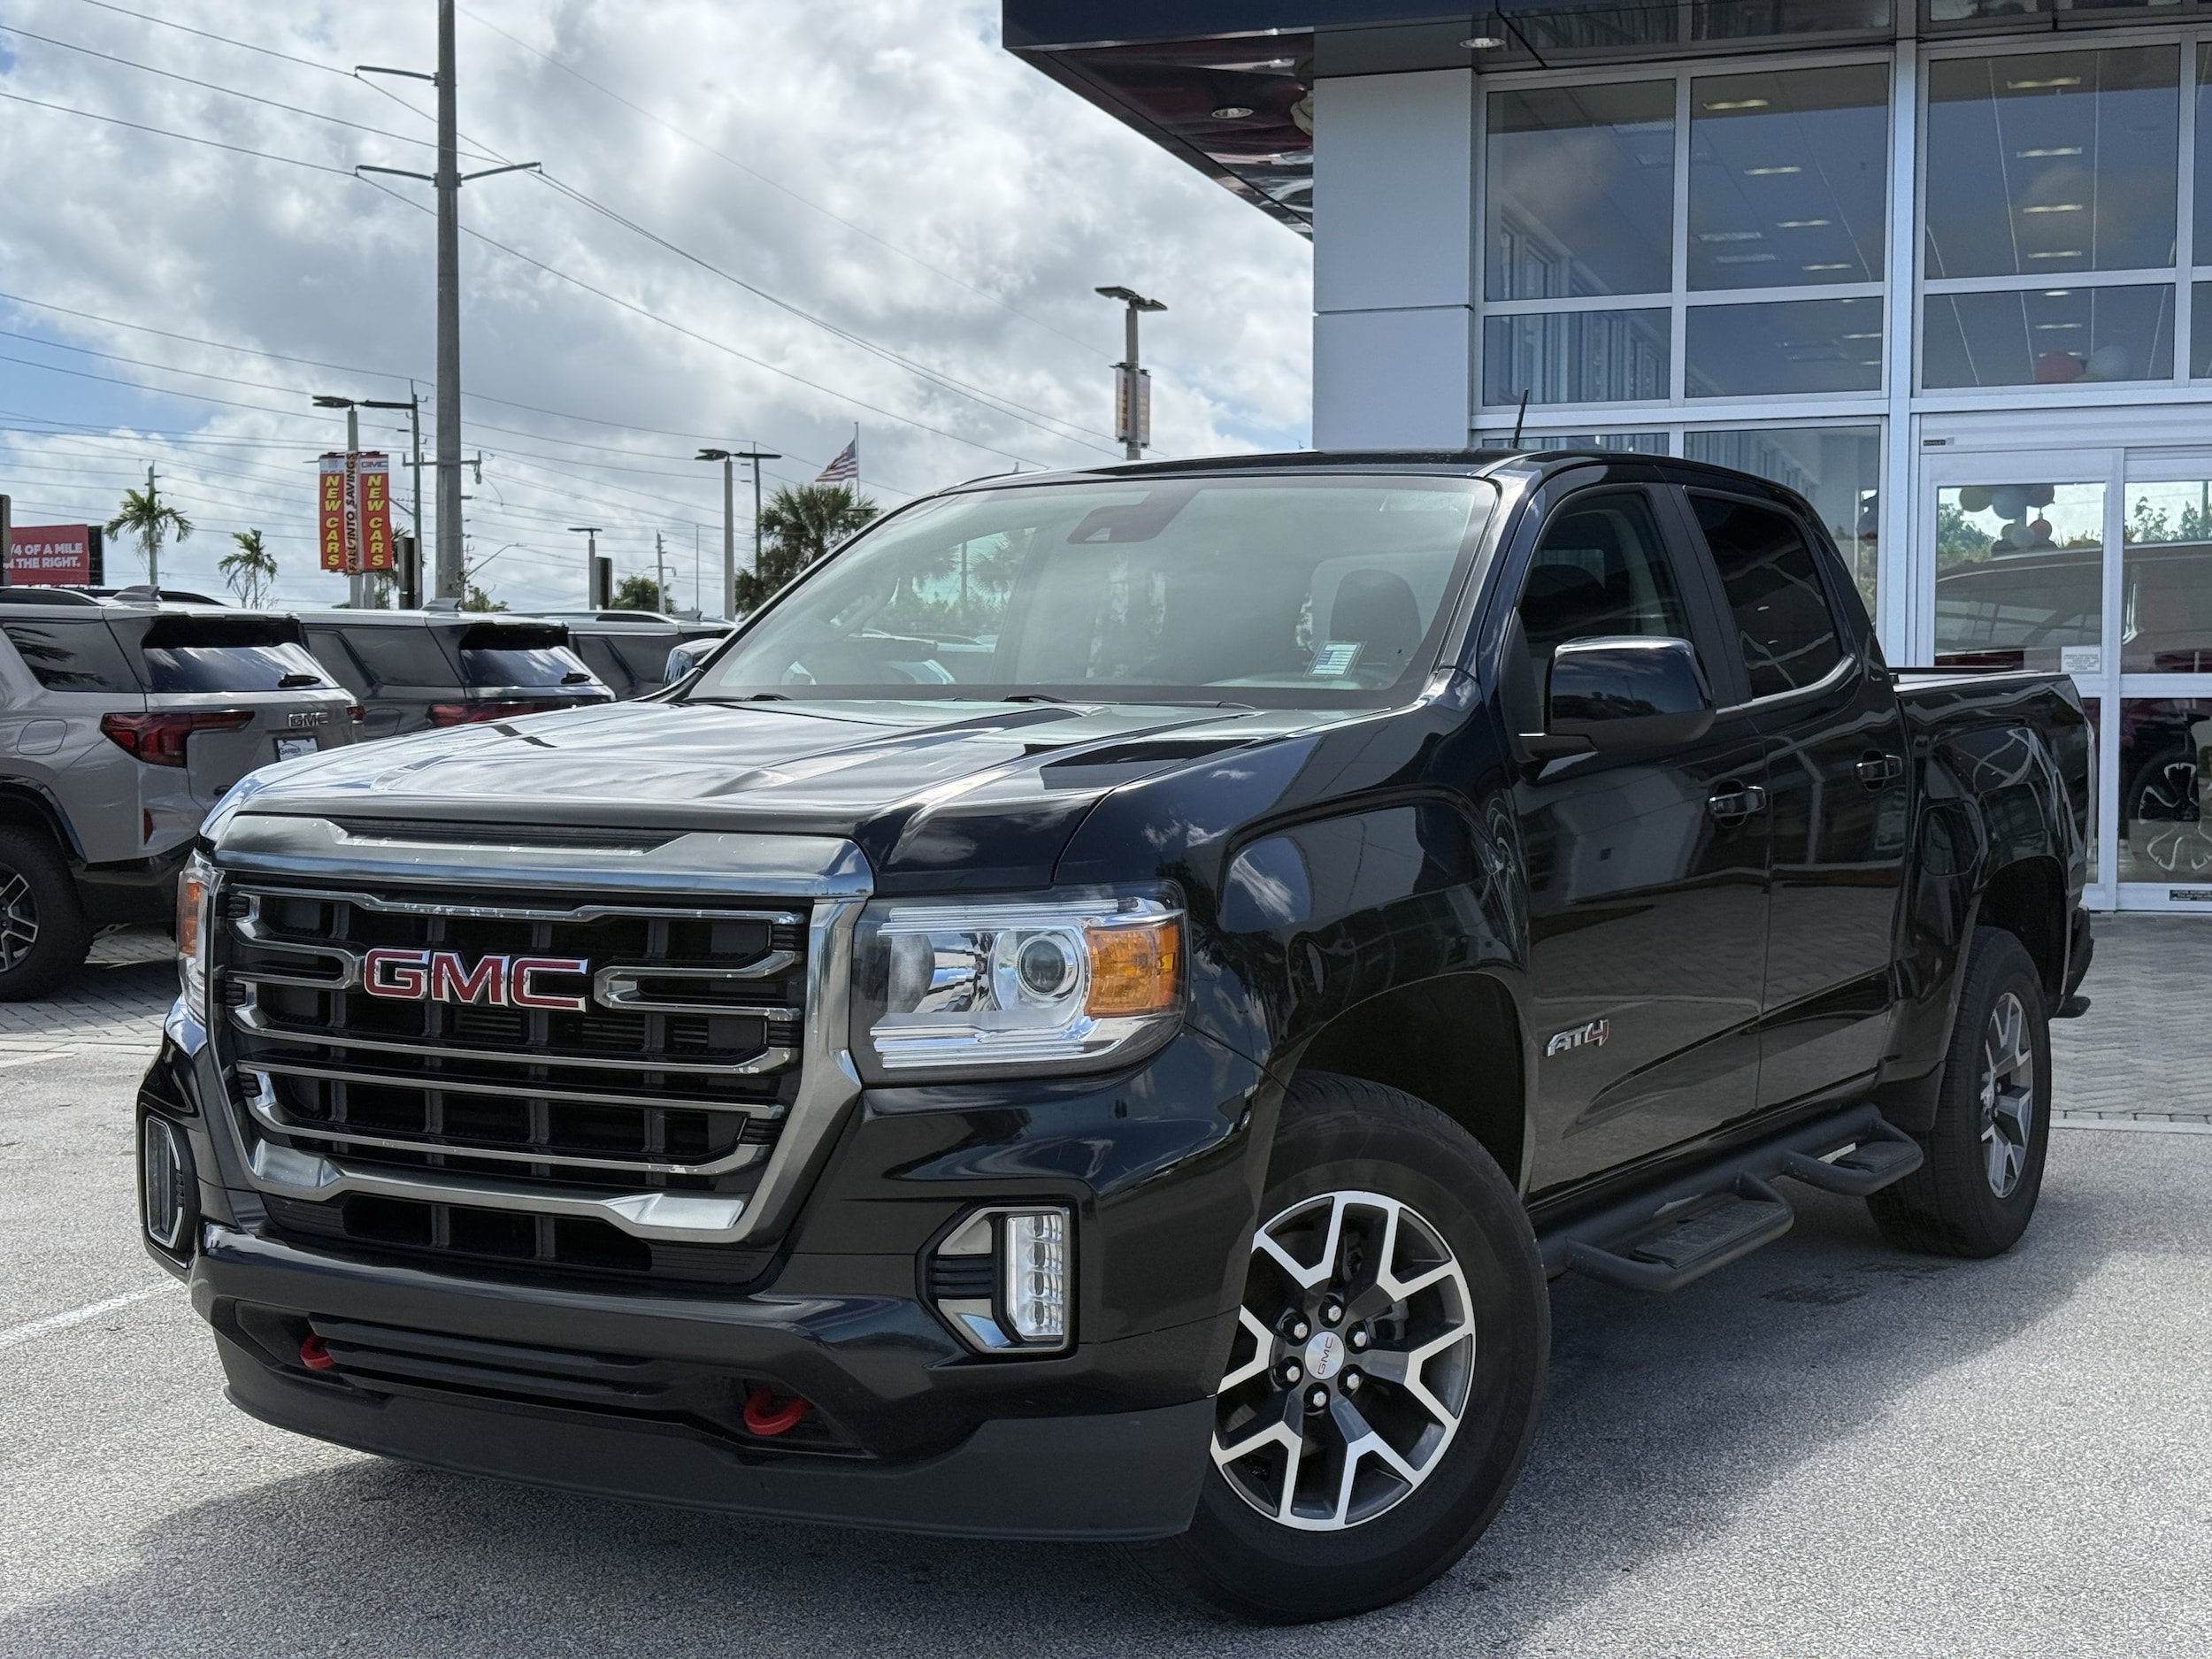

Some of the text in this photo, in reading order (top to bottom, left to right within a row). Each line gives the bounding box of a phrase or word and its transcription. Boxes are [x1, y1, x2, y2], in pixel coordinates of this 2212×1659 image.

[325, 474, 342, 511] NEW
[346, 452, 357, 507] SAVINGS
[346, 511, 356, 541] INTO
[367, 474, 385, 566] NEW CARS
[11, 542, 83, 556] /4 OF A MILE
[326, 516, 341, 566] CARS
[16, 557, 40, 569] THE
[42, 556, 81, 568] RIGHT.
[288, 711, 328, 728] GMC
[364, 948, 588, 1013] GMC
[1547, 1018, 1609, 1057] AT4
[1317, 1336, 1333, 1375] GMC
